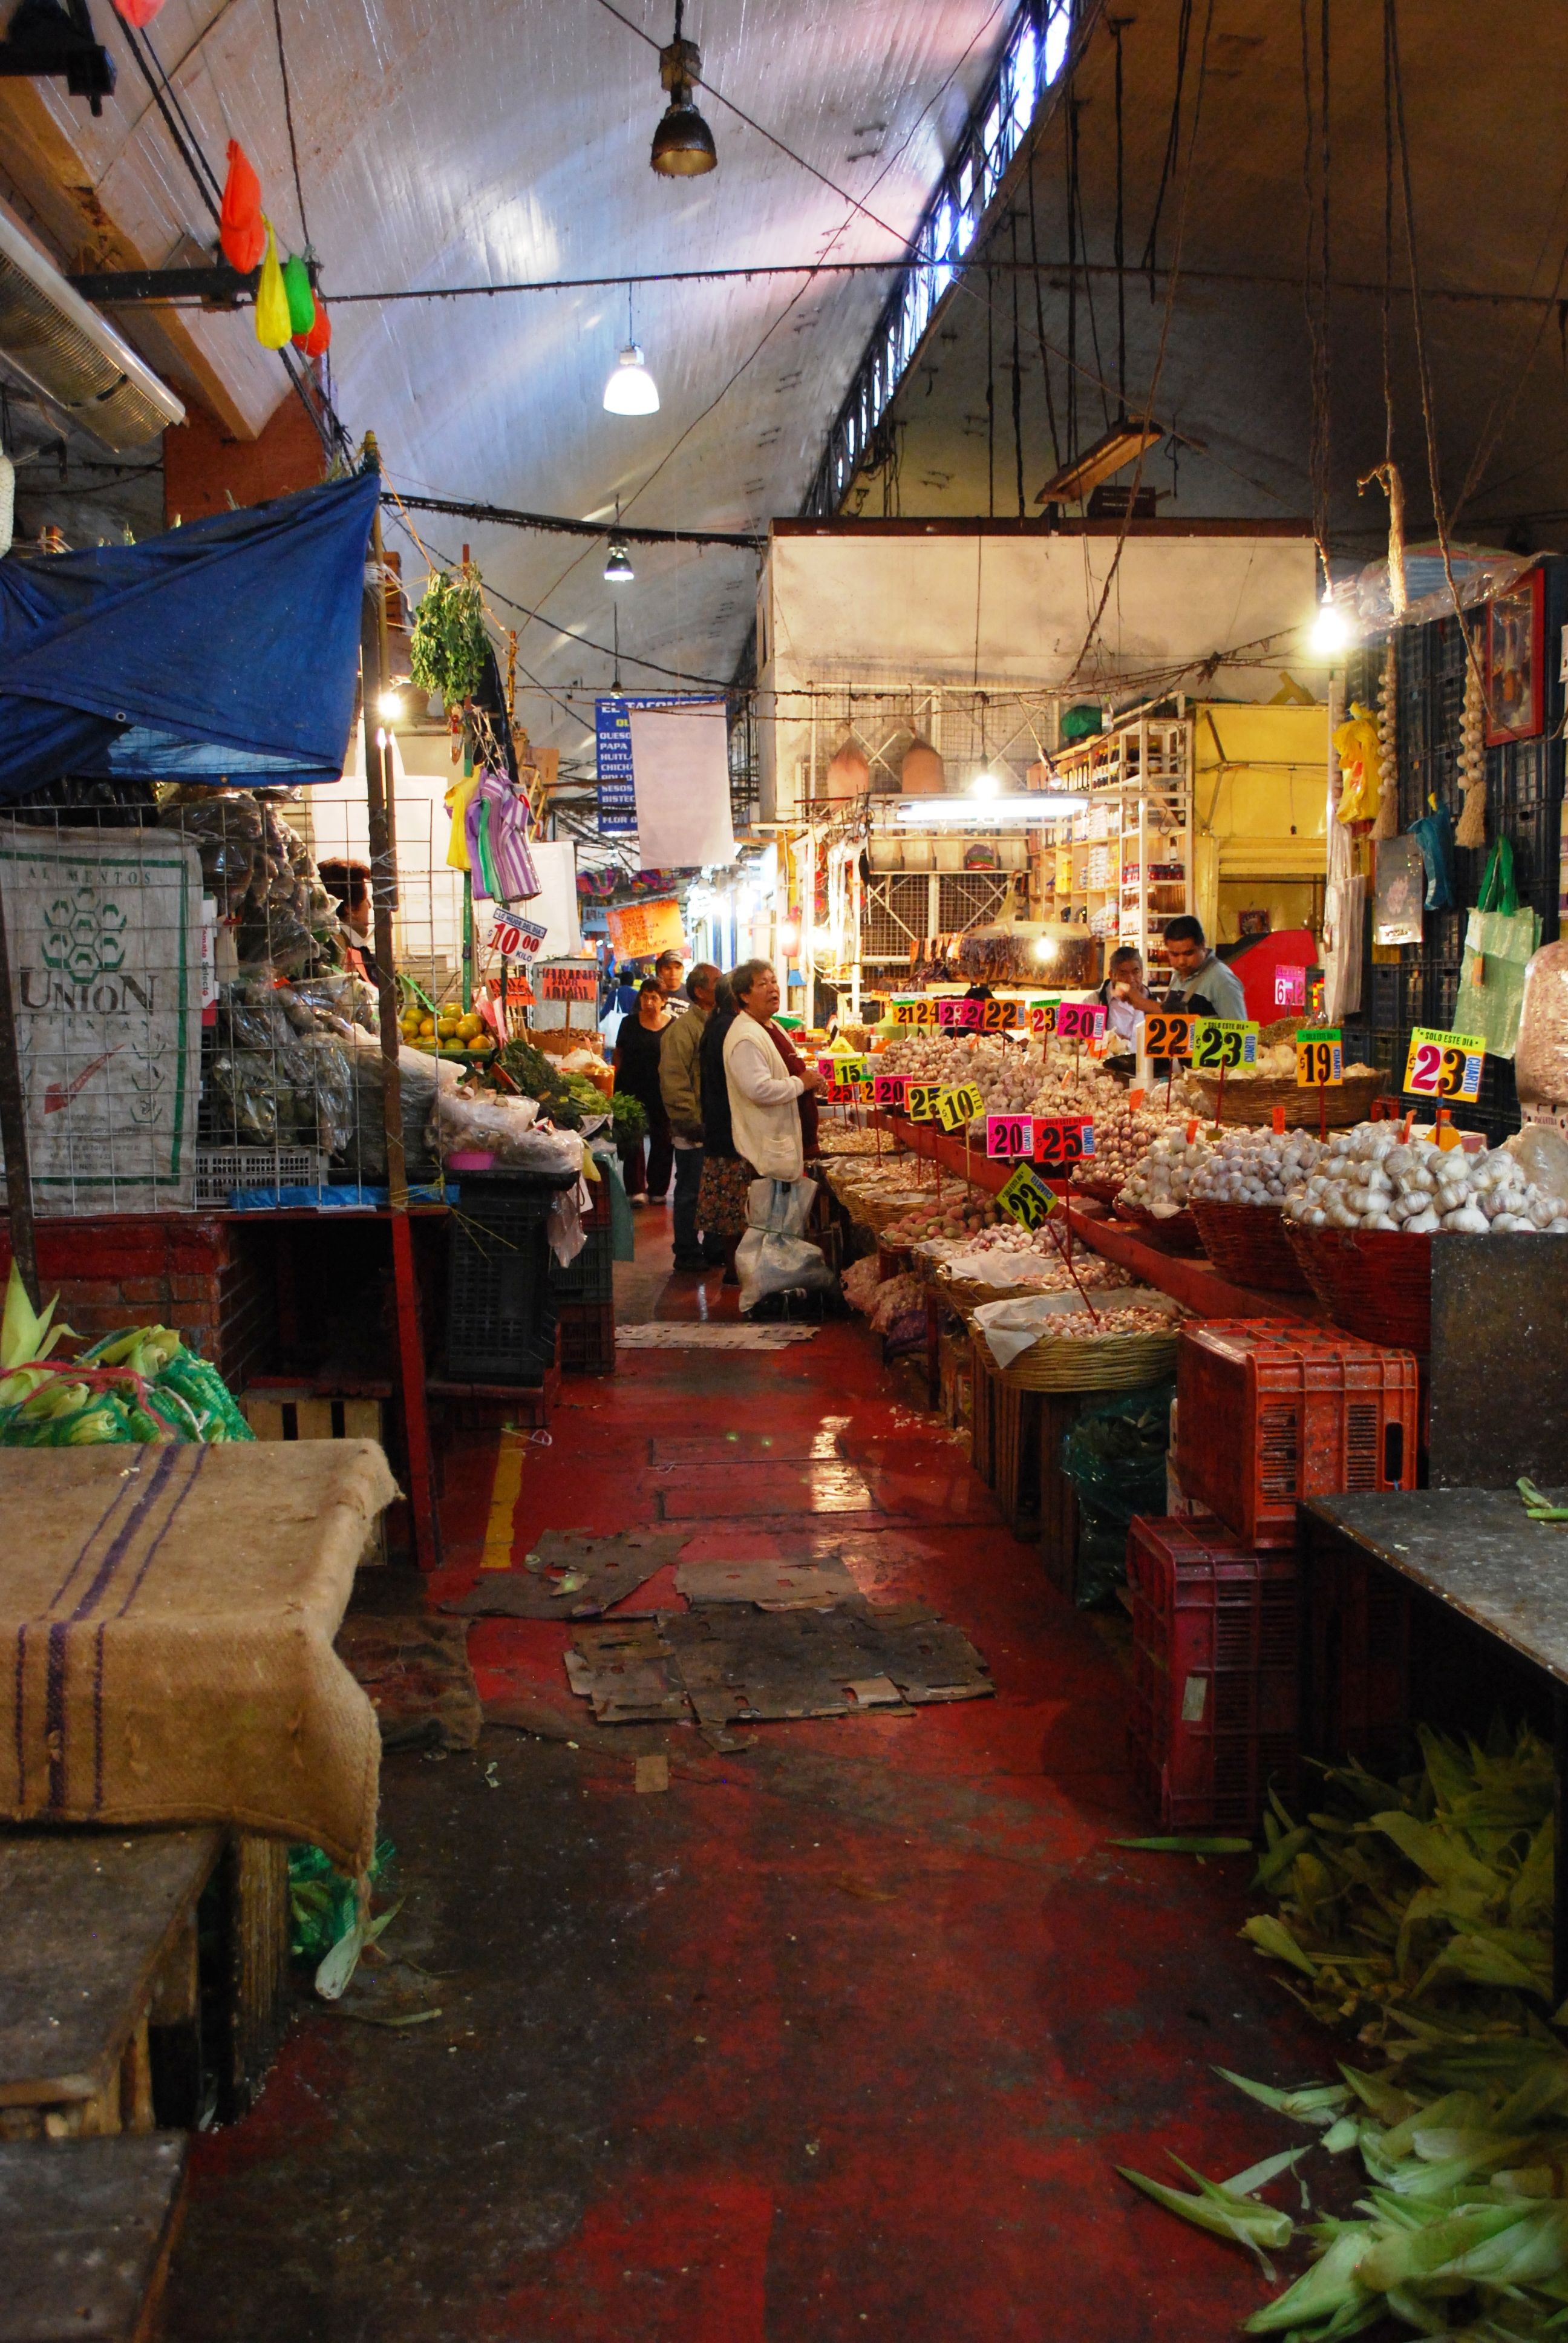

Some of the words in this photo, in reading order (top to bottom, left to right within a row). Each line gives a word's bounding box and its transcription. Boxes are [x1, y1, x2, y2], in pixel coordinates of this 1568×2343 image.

[601, 702, 621, 713] EL
[29, 867, 151, 884] ALMENTOS
[486, 923, 520, 954] 10
[522, 935, 540, 952] 00
[515, 951, 532, 962] KILO
[20, 966, 158, 1017] UNION
[898, 1006, 913, 1023] 21
[916, 1003, 939, 1023] 24
[986, 1001, 1016, 1028] 22
[1033, 1007, 1056, 1032] 23
[1063, 1009, 1094, 1037] 20
[1146, 1018, 1188, 1055] 22
[1199, 1027, 1243, 1067] 23
[1244, 1036, 1255, 1062] CUARTO
[1425, 1032, 1442, 1042] SOLO
[1443, 1035, 1460, 1044] ESTE
[1462, 1037, 1474, 1046] DIA
[840, 1064, 860, 1083] 15
[1304, 1043, 1331, 1083] 19
[1411, 1045, 1466, 1095] 23
[1463, 1057, 1481, 1092] CUARTO
[832, 1084, 852, 1101] 25
[880, 1081, 904, 1102] 20
[910, 1087, 941, 1118] 25
[970, 1087, 983, 1110] KILO
[944, 1090, 975, 1126] 10
[995, 1123, 1023, 1154] 20
[1042, 1124, 1083, 1160] 25
[1083, 1127, 1094, 1153] CUARTO
[1030, 1175, 1053, 1200] CUARTO
[1008, 1183, 1048, 1231] 23
